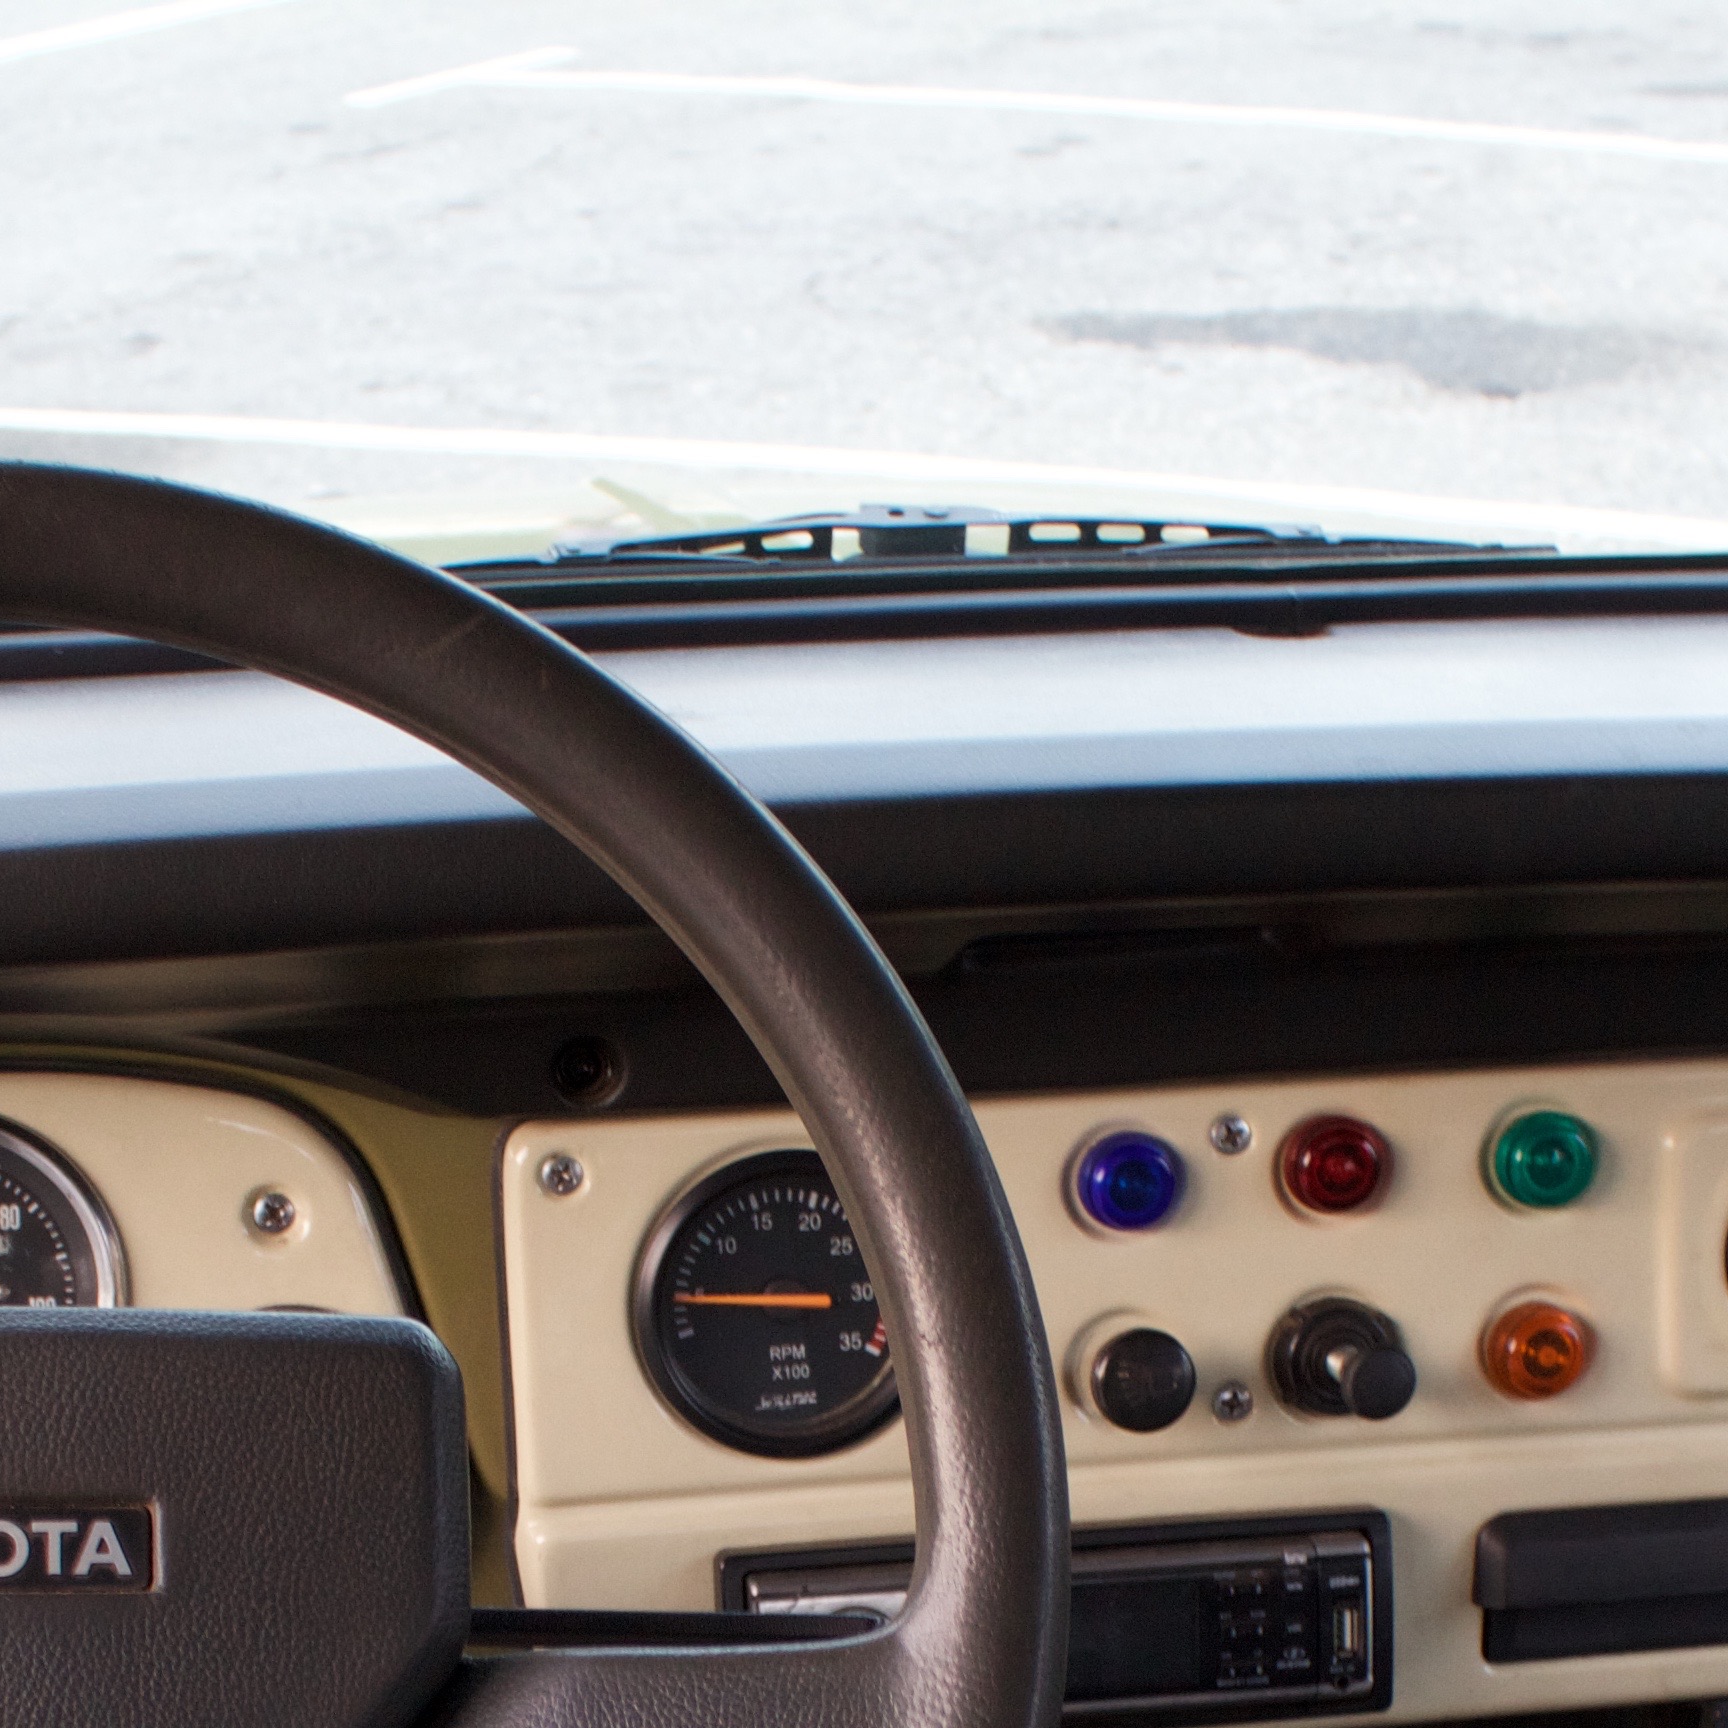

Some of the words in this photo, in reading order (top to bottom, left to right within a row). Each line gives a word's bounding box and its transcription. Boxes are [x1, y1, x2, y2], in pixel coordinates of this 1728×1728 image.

[751, 1212, 774, 1232] 15
[798, 1210, 822, 1232] 20
[716, 1235, 737, 1256] 10
[830, 1236, 853, 1257] 25
[850, 1282, 874, 1302] 30
[839, 1331, 862, 1352] 35
[769, 1343, 806, 1362] RPM
[772, 1362, 811, 1382] X100
